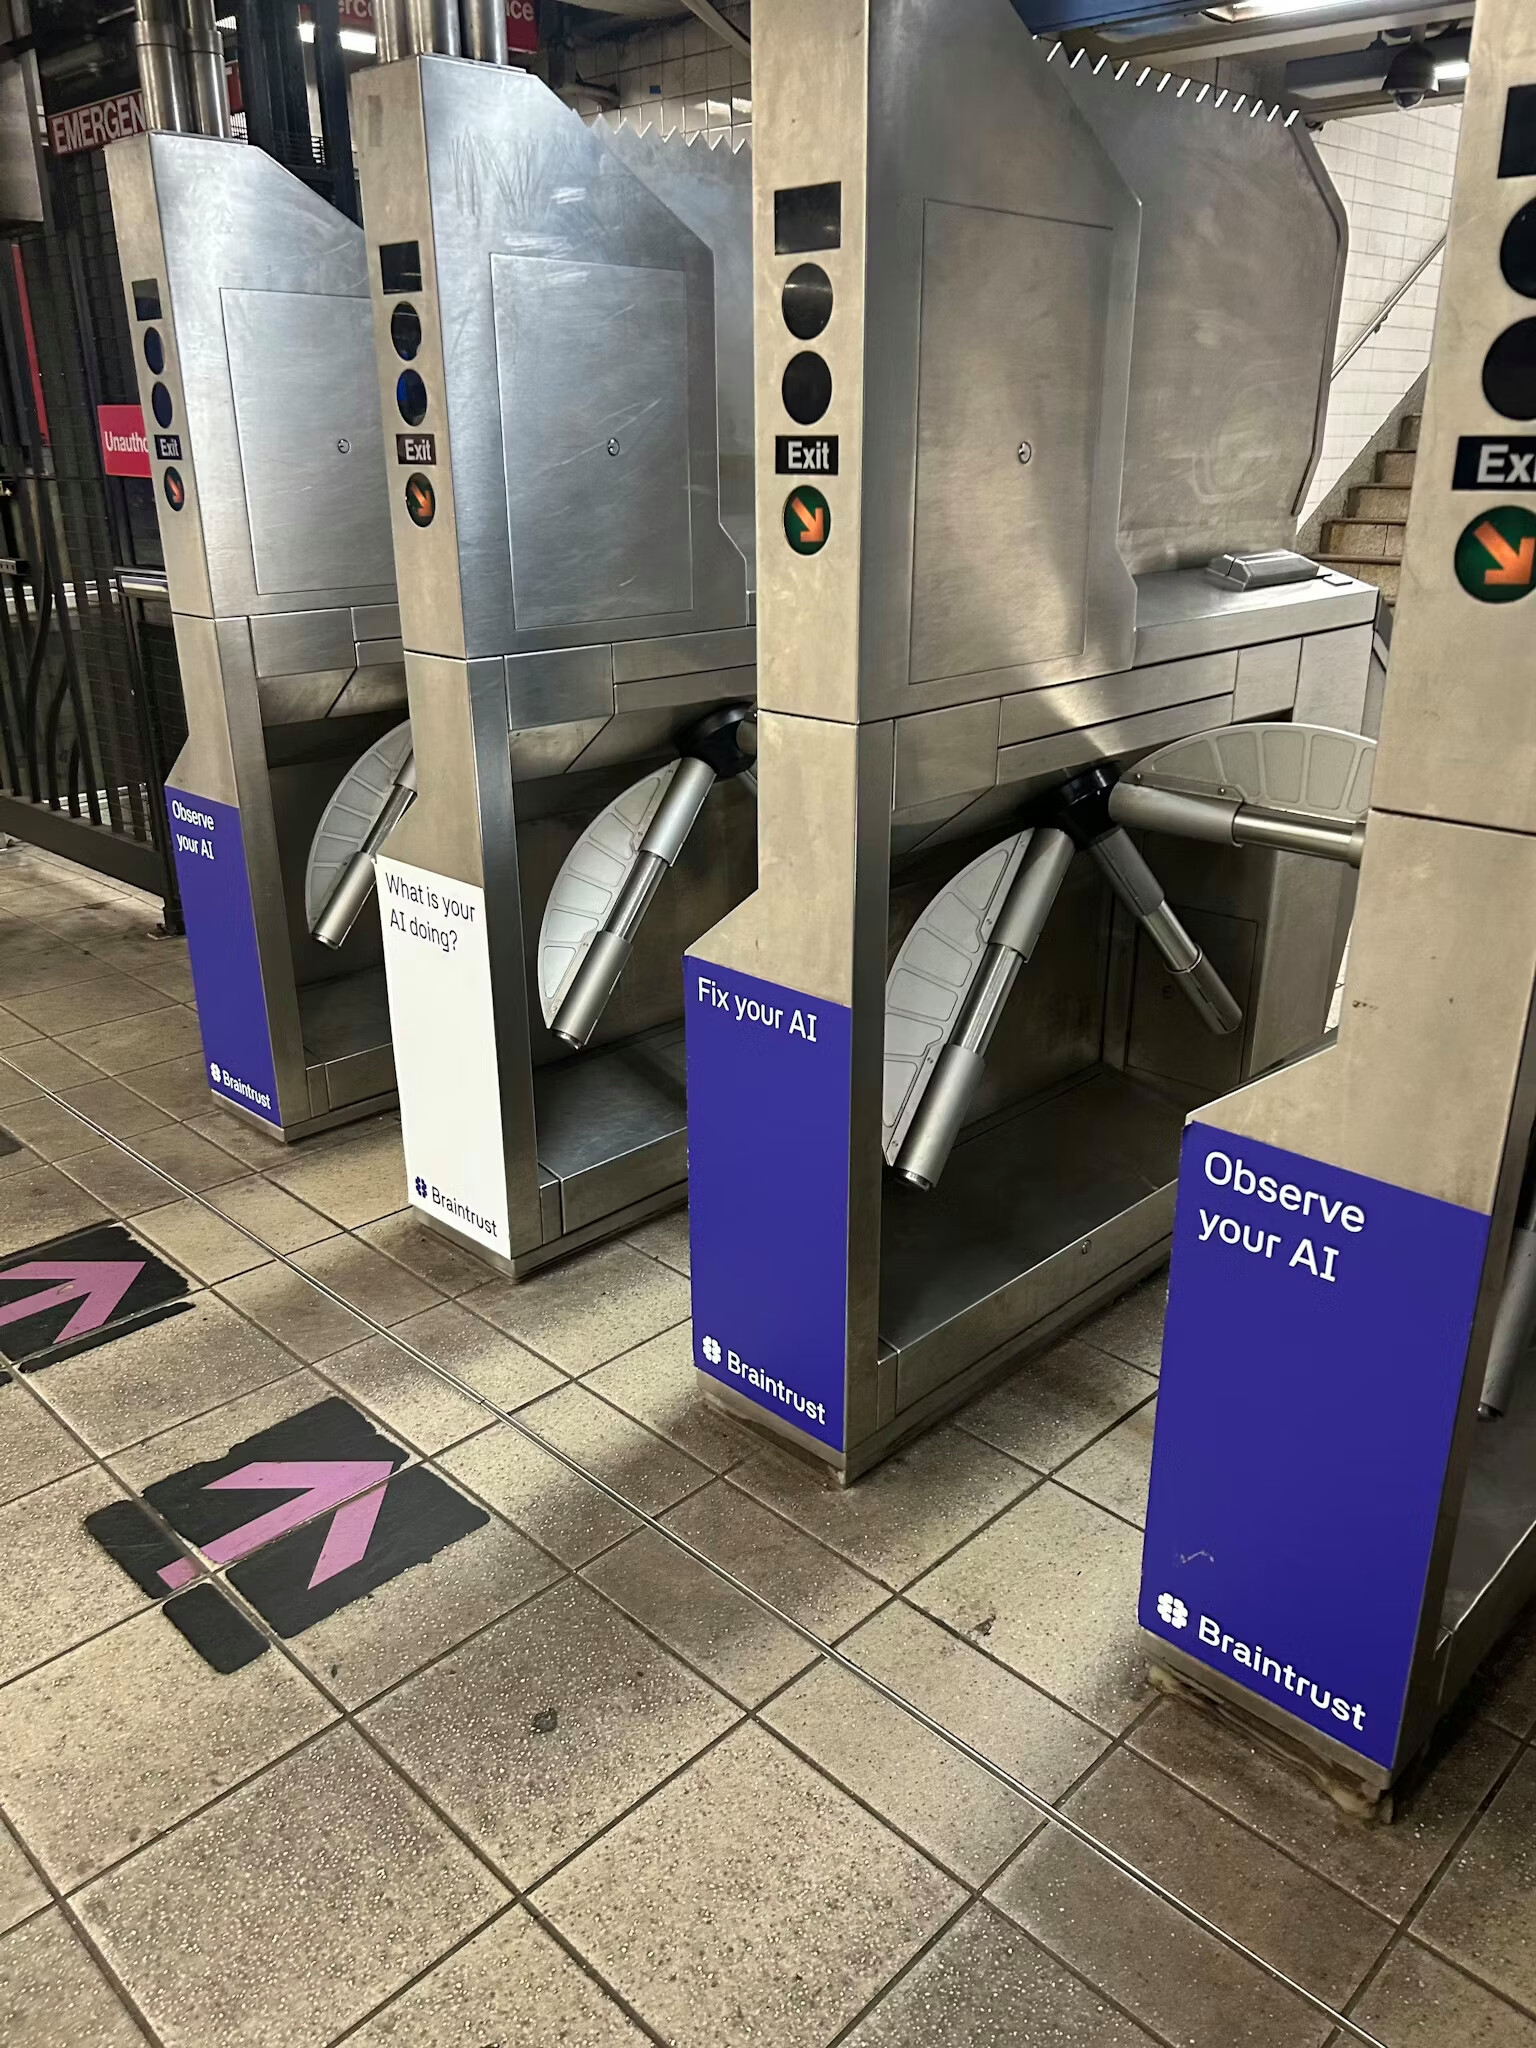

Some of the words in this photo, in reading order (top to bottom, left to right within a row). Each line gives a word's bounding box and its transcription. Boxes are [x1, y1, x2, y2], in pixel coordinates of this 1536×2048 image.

[53, 93, 146, 152] EMERGEN
[160, 438, 180, 457] Exit
[404, 438, 432, 461] Exit
[787, 440, 830, 470] Exit
[1476, 443, 1536, 483] Ex
[172, 800, 215, 831] Observe
[175, 832, 199, 855] your
[200, 837, 215, 861] AI
[385, 872, 425, 906] What
[427, 890, 439, 910] is
[441, 896, 476, 923] your
[389, 908, 407, 933] AI
[409, 915, 458, 953] doing?
[698, 976, 730, 1012] Fix
[734, 994, 784, 1029] your
[788, 1009, 818, 1043] AI
[222, 1068, 272, 1110] Braintrust
[432, 1185, 497, 1236] Braintrust
[1203, 1151, 1366, 1234] Observe
[1198, 1207, 1282, 1259] your
[1288, 1238, 1340, 1283] AI
[726, 1349, 827, 1426] Braintrust
[1197, 1613, 1367, 1732] Braintrust
